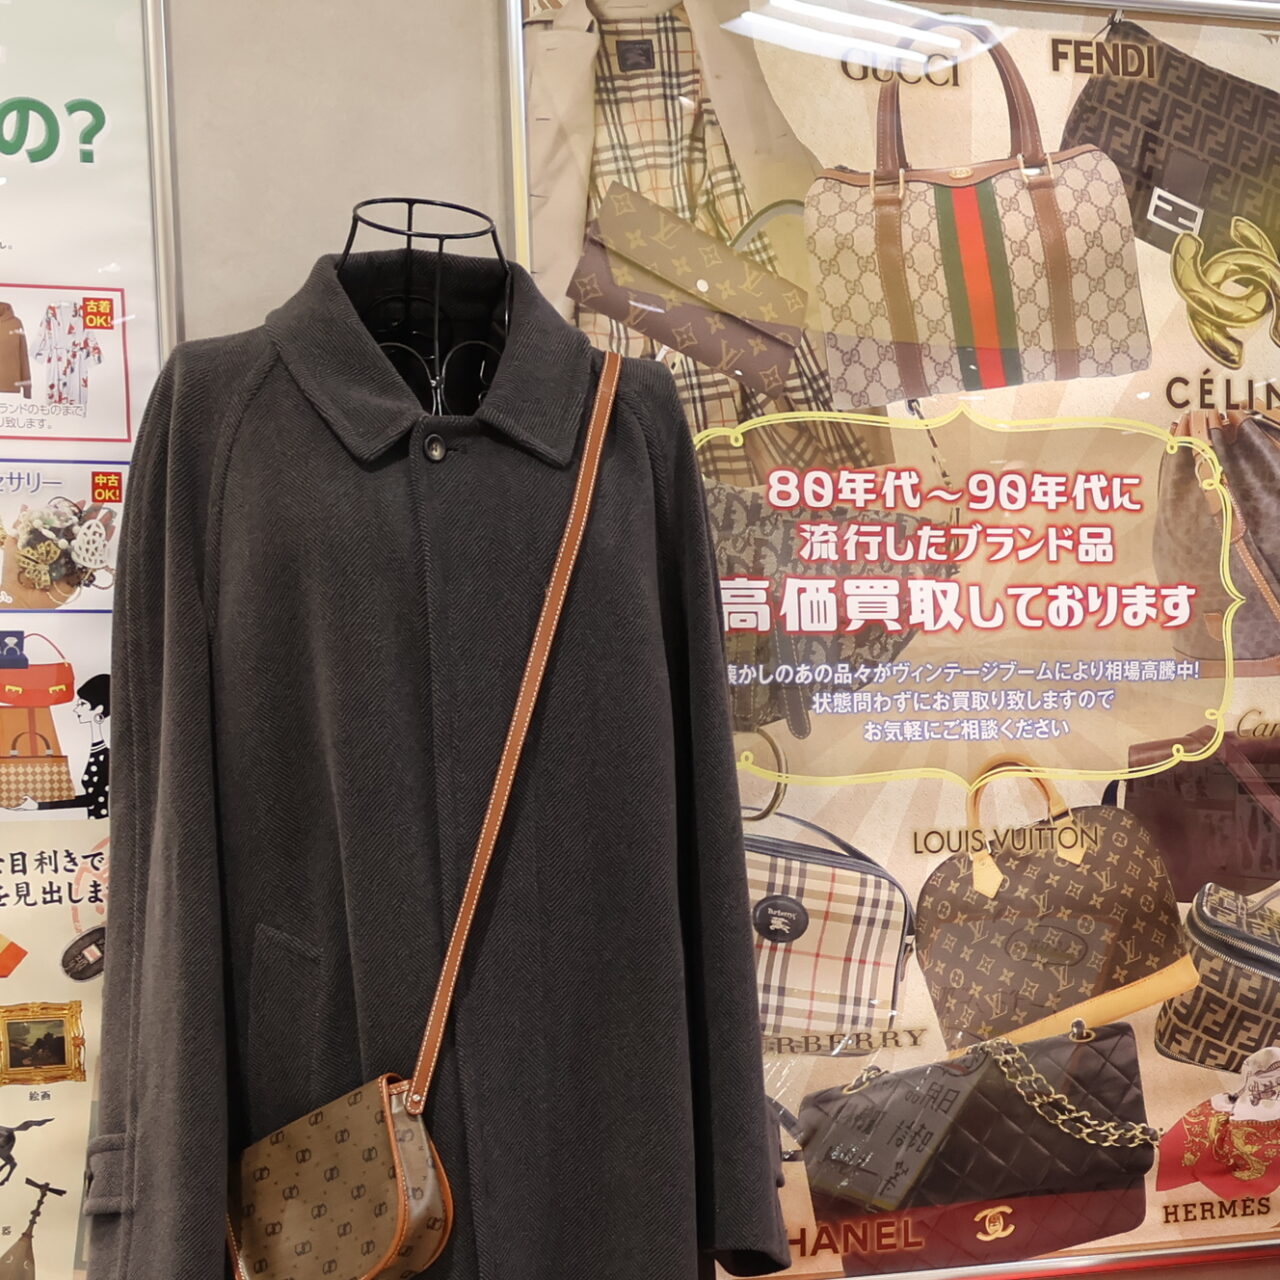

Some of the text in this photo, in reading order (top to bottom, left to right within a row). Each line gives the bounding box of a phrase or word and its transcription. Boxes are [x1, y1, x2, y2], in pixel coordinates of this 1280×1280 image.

[841, 47, 960, 87] GUCCI
[1051, 38, 1155, 79] FENDI
[86, 315, 112, 328] OK!
[95, 474, 119, 486] 中古
[95, 489, 120, 500] OK!
[798, 524, 1115, 564] 流行したブランド品
[722, 577, 1197, 634] 高価買取しております
[812, 688, 1115, 711] 状態問わずにお買取り致しますので
[863, 718, 1070, 742] お気軽にご相談ください
[914, 826, 1099, 855] LOUIS VUITTON
[0, 880, 109, 907] を見出しま
[762, 1029, 927, 1055] RBERRY
[1162, 1196, 1271, 1223] HERMÈS
[788, 1218, 924, 1257] HANEL
